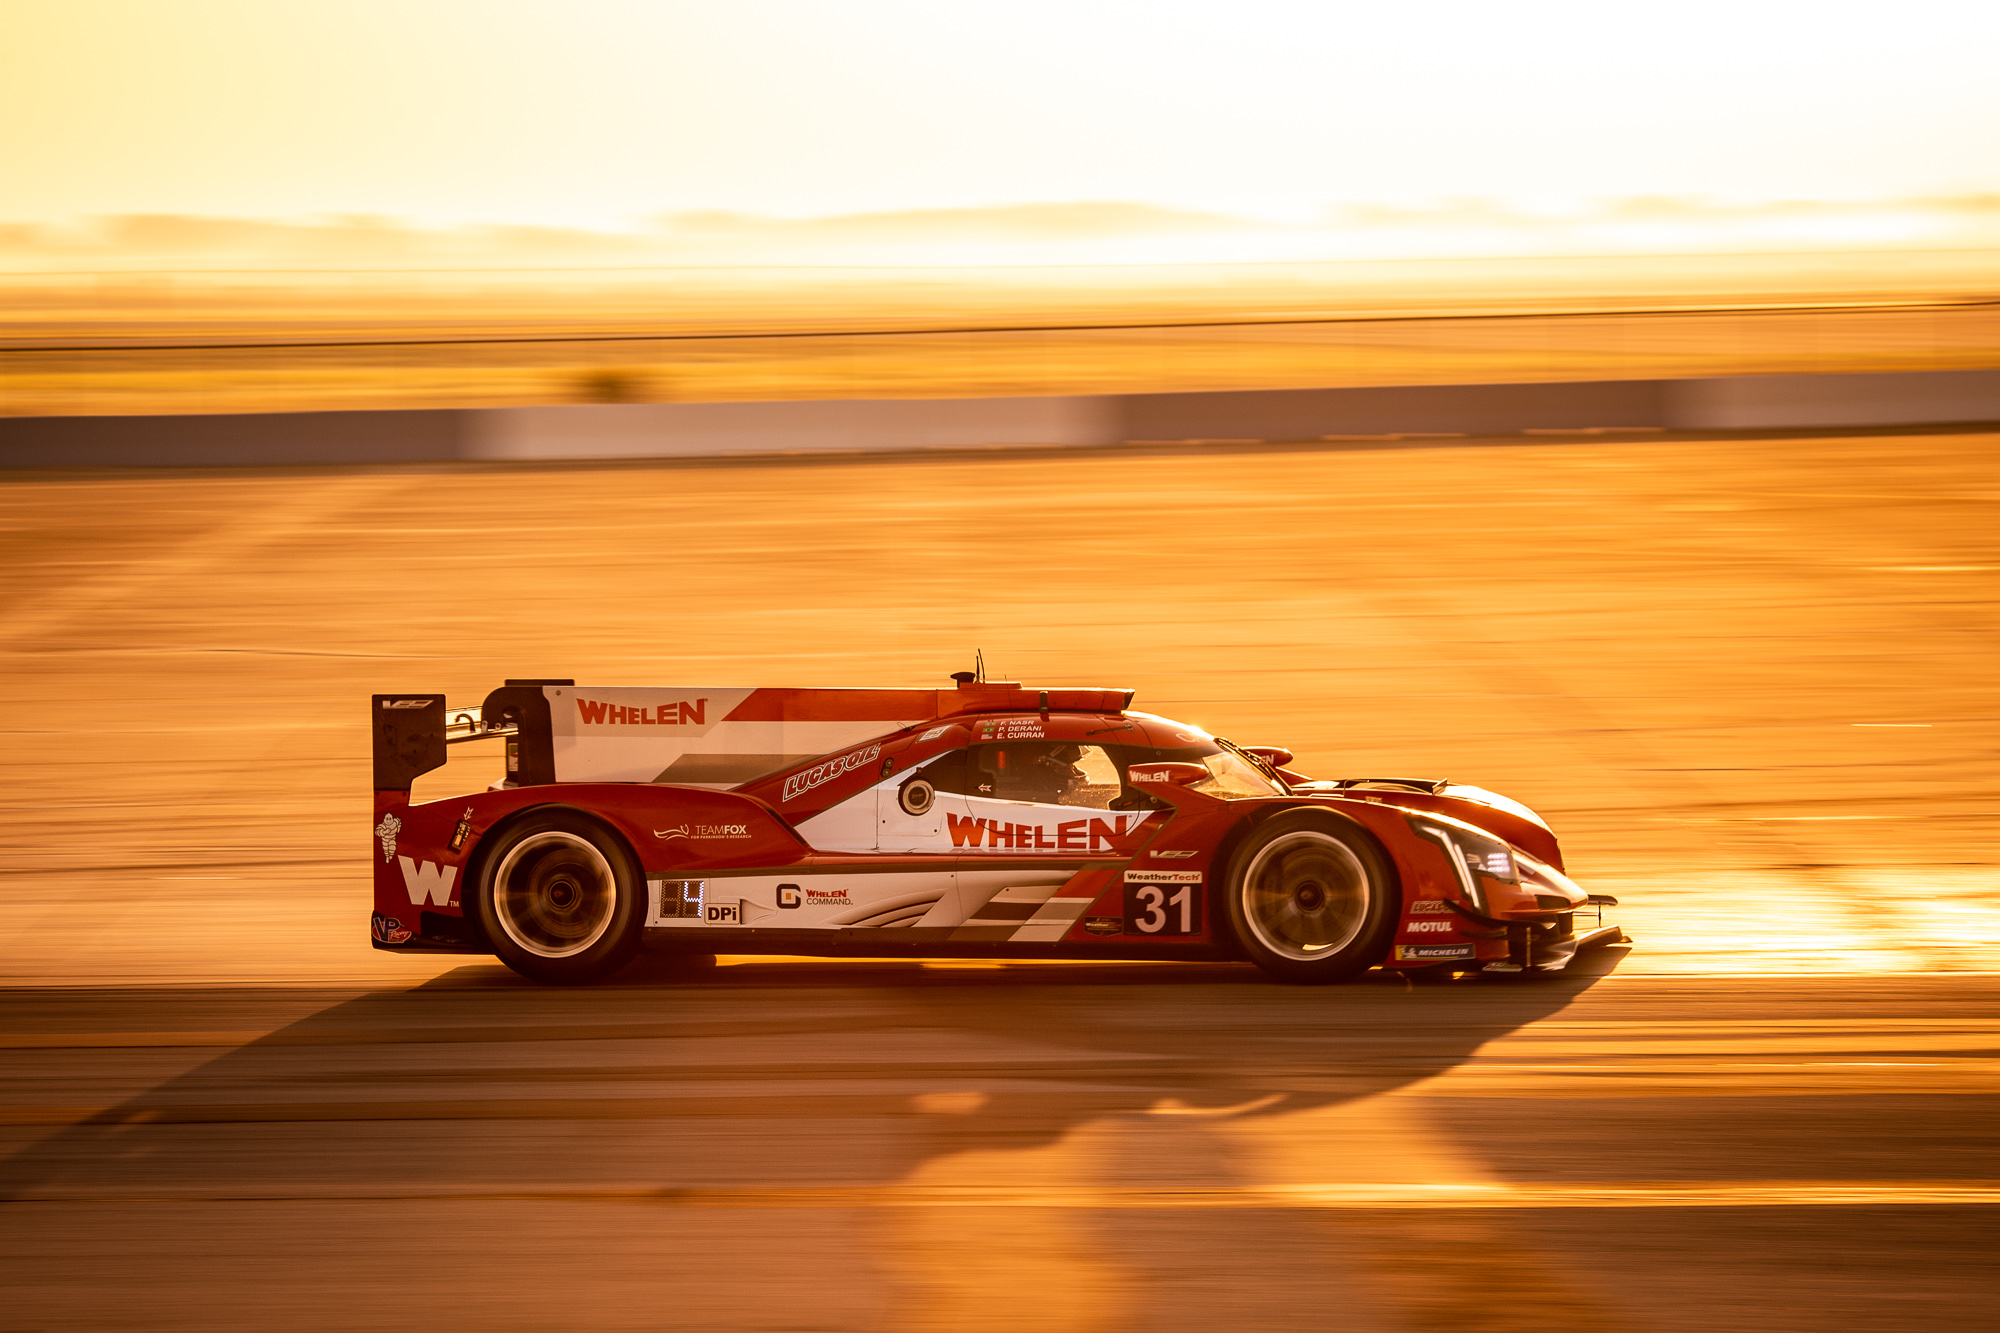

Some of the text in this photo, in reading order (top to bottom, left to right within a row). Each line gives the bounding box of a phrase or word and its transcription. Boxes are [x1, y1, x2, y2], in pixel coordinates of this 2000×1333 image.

[576, 698, 706, 725] WHELEN
[782, 743, 881, 803] LUCAS OIL
[1129, 770, 1169, 782] WHELEN
[946, 812, 1128, 849] WHELEN
[397, 854, 458, 907] W
[1127, 873, 1199, 881] WeatherTech
[806, 889, 847, 898] WHELEN
[708, 907, 737, 921] DPi
[1135, 885, 1192, 933] 31
[372, 916, 401, 943] VP
[1406, 921, 1453, 933] MOTUL
[1418, 948, 1469, 956] MICHELIN
